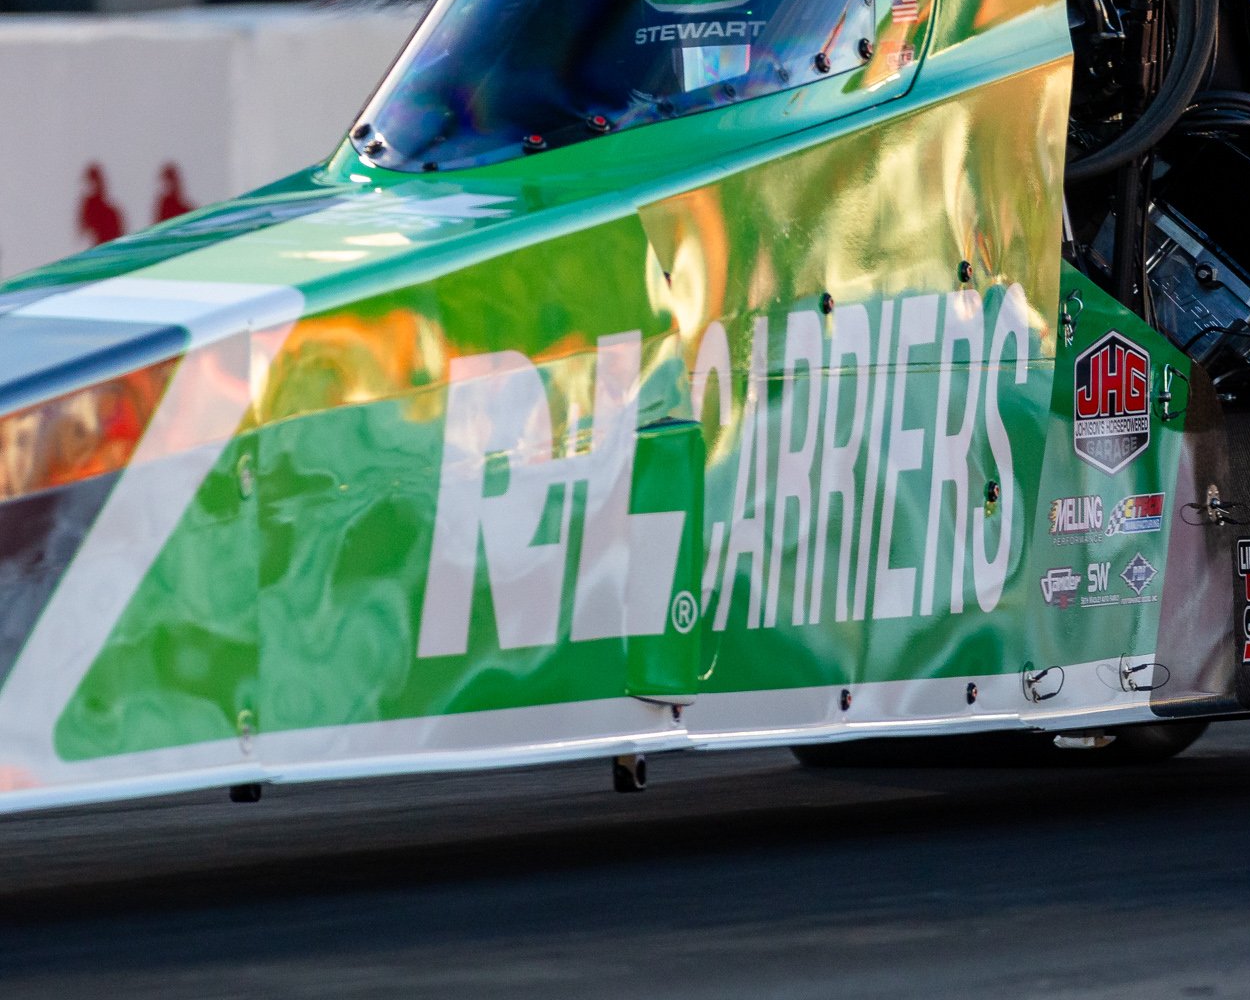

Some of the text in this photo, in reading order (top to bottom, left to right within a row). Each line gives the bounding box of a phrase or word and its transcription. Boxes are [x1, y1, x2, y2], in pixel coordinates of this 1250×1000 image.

[634, 20, 767, 45] STEWART
[1077, 344, 1147, 418] JHG
[1076, 417, 1148, 437] JOHNSON'S HORSEPOWERED
[690, 282, 1030, 632] CARRIERS
[1086, 436, 1138, 459] GARAGE
[1054, 496, 1103, 533] MELLING
[1051, 533, 1103, 546] PERFORMANCE
[1088, 562, 1111, 593] SW
